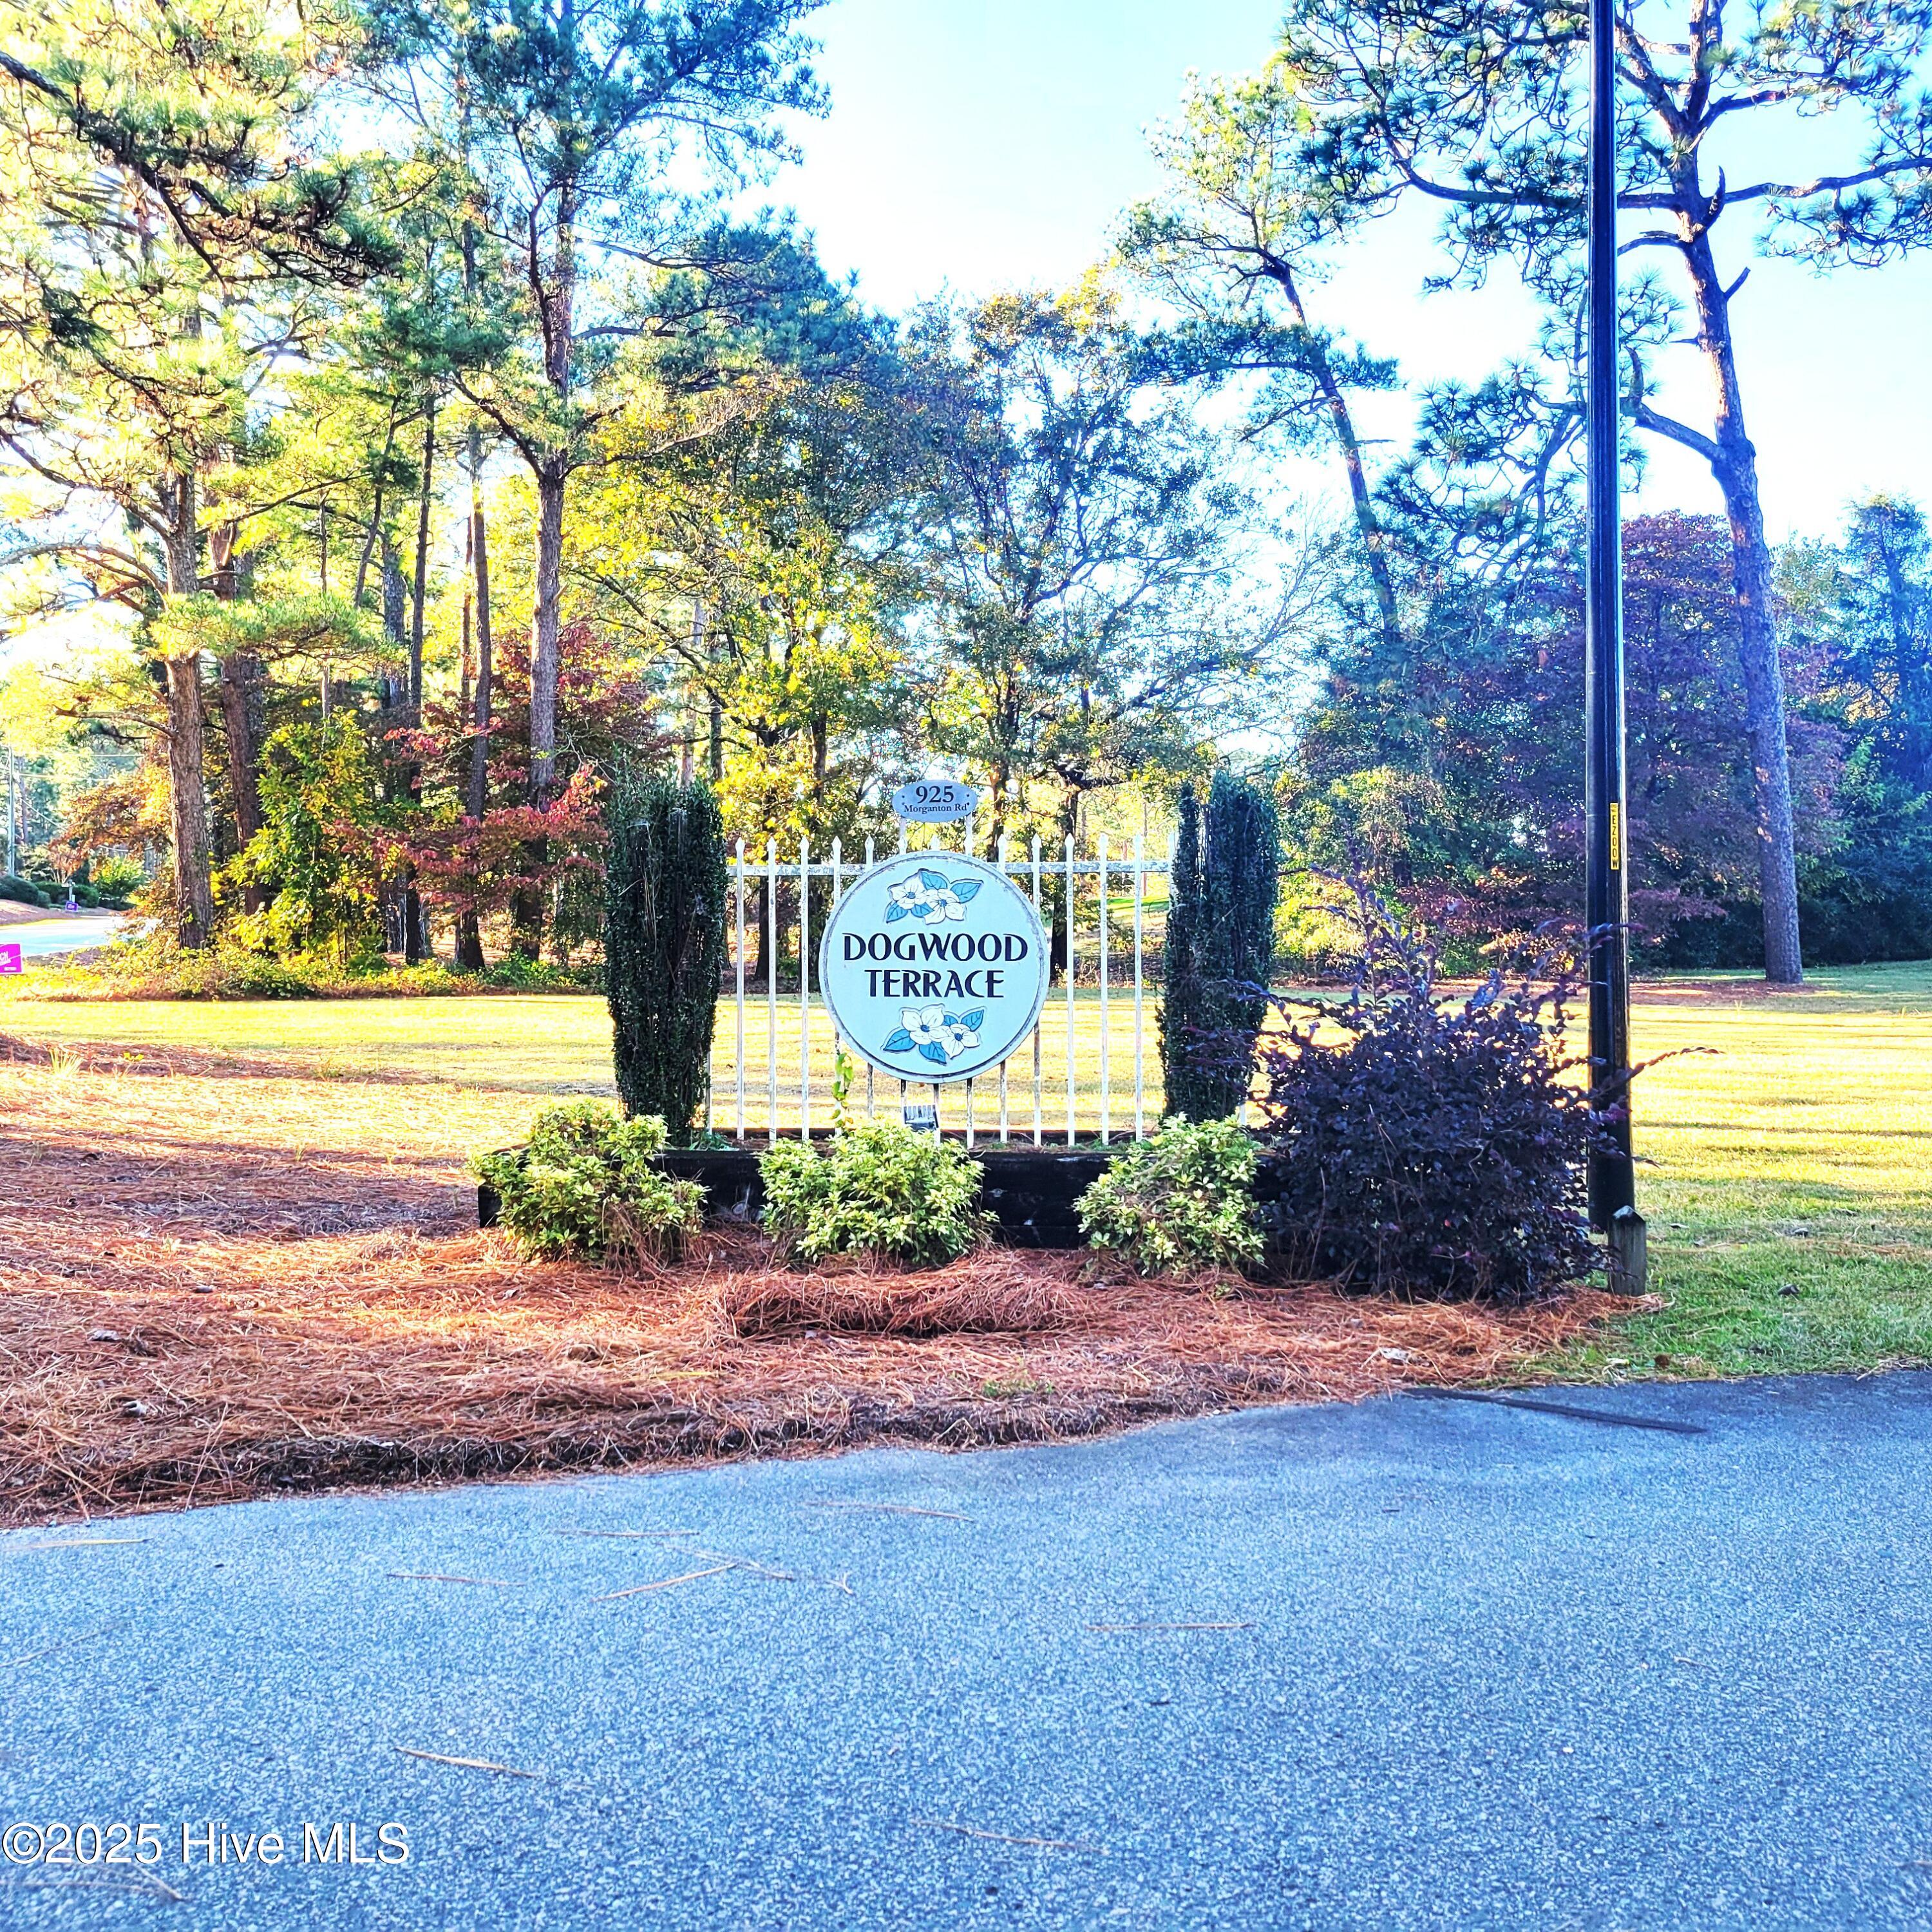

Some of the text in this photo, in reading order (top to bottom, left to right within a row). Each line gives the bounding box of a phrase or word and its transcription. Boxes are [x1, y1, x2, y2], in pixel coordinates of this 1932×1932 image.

[916, 785, 954, 804] 925
[904, 803, 967, 814] Morganton Rd
[842, 933, 1028, 961] DOGWOOD
[865, 969, 1005, 998] TERRACE
